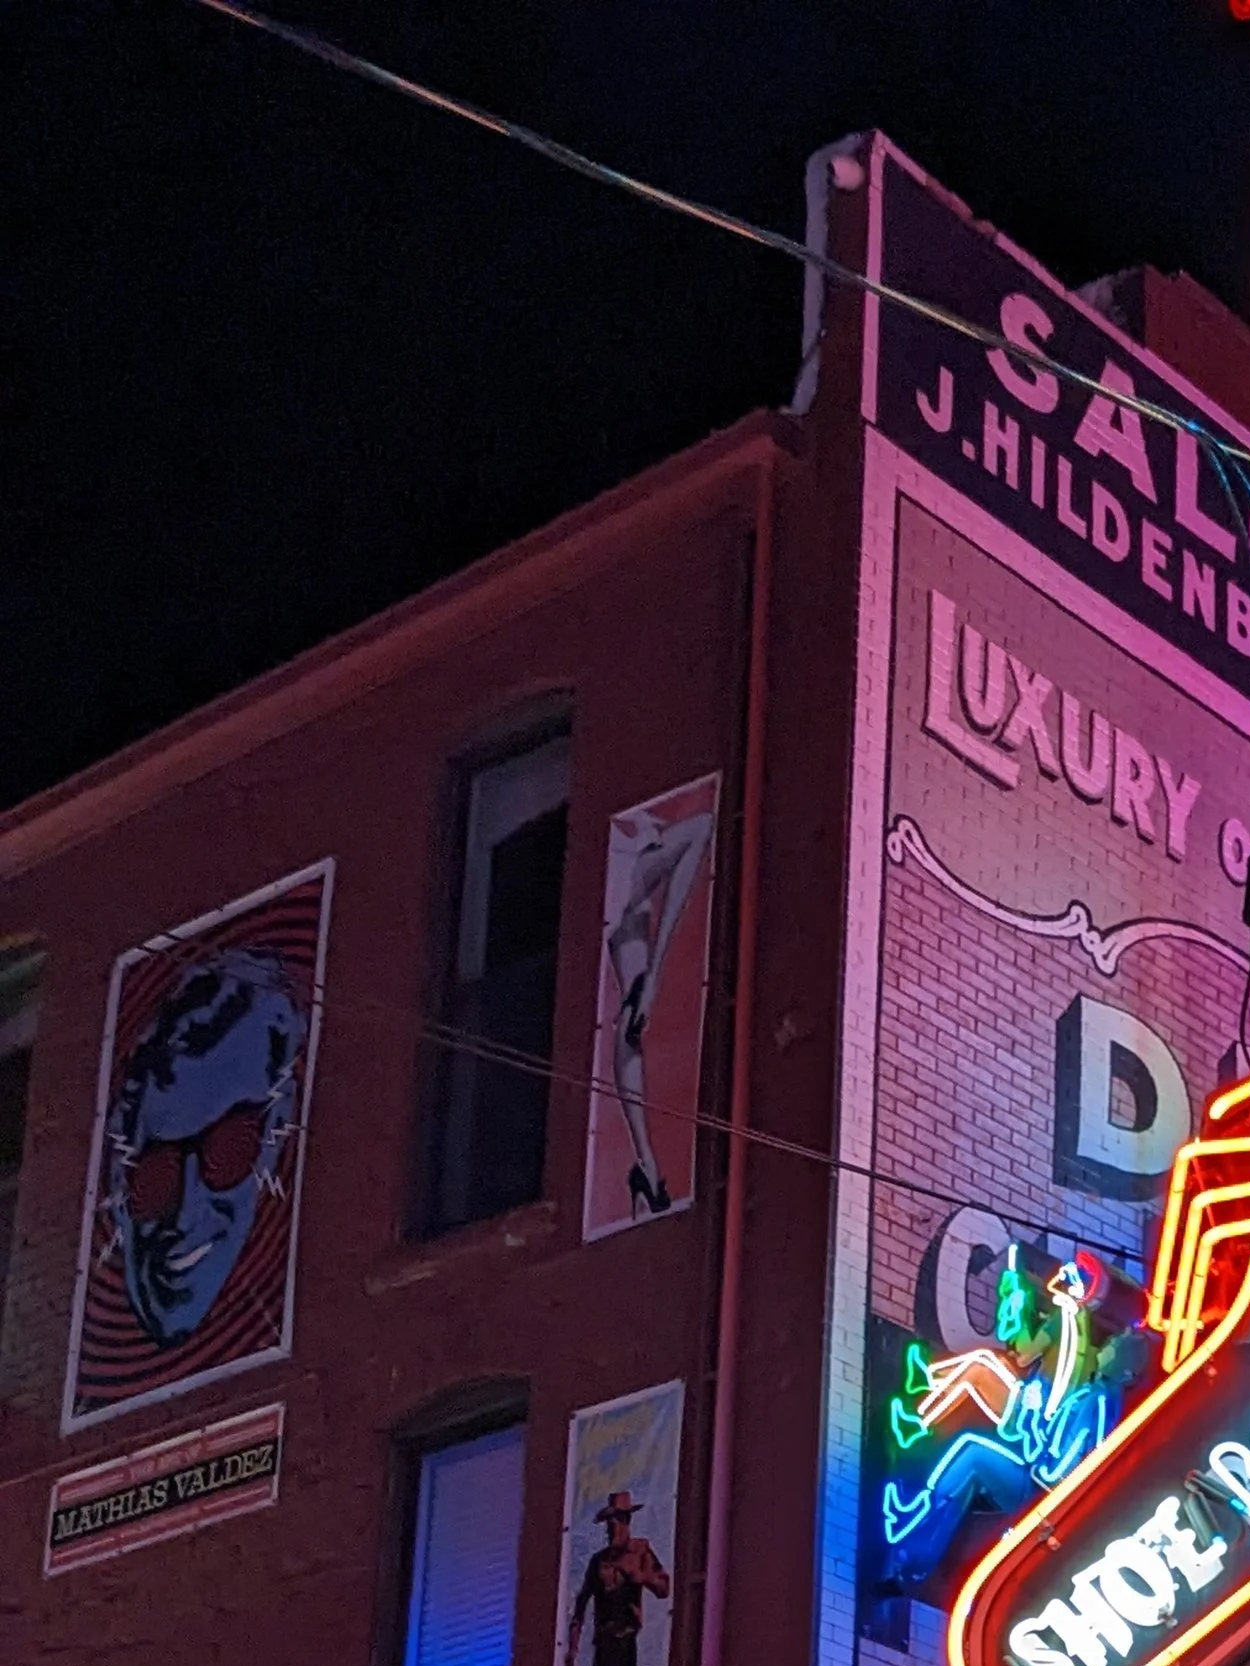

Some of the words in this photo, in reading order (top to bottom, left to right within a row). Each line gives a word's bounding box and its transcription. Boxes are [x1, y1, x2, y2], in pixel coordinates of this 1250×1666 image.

[924, 590, 1200, 863] LUXURY
[54, 1479, 169, 1541] MATHIAS
[176, 1444, 275, 1500] VALDEZ
